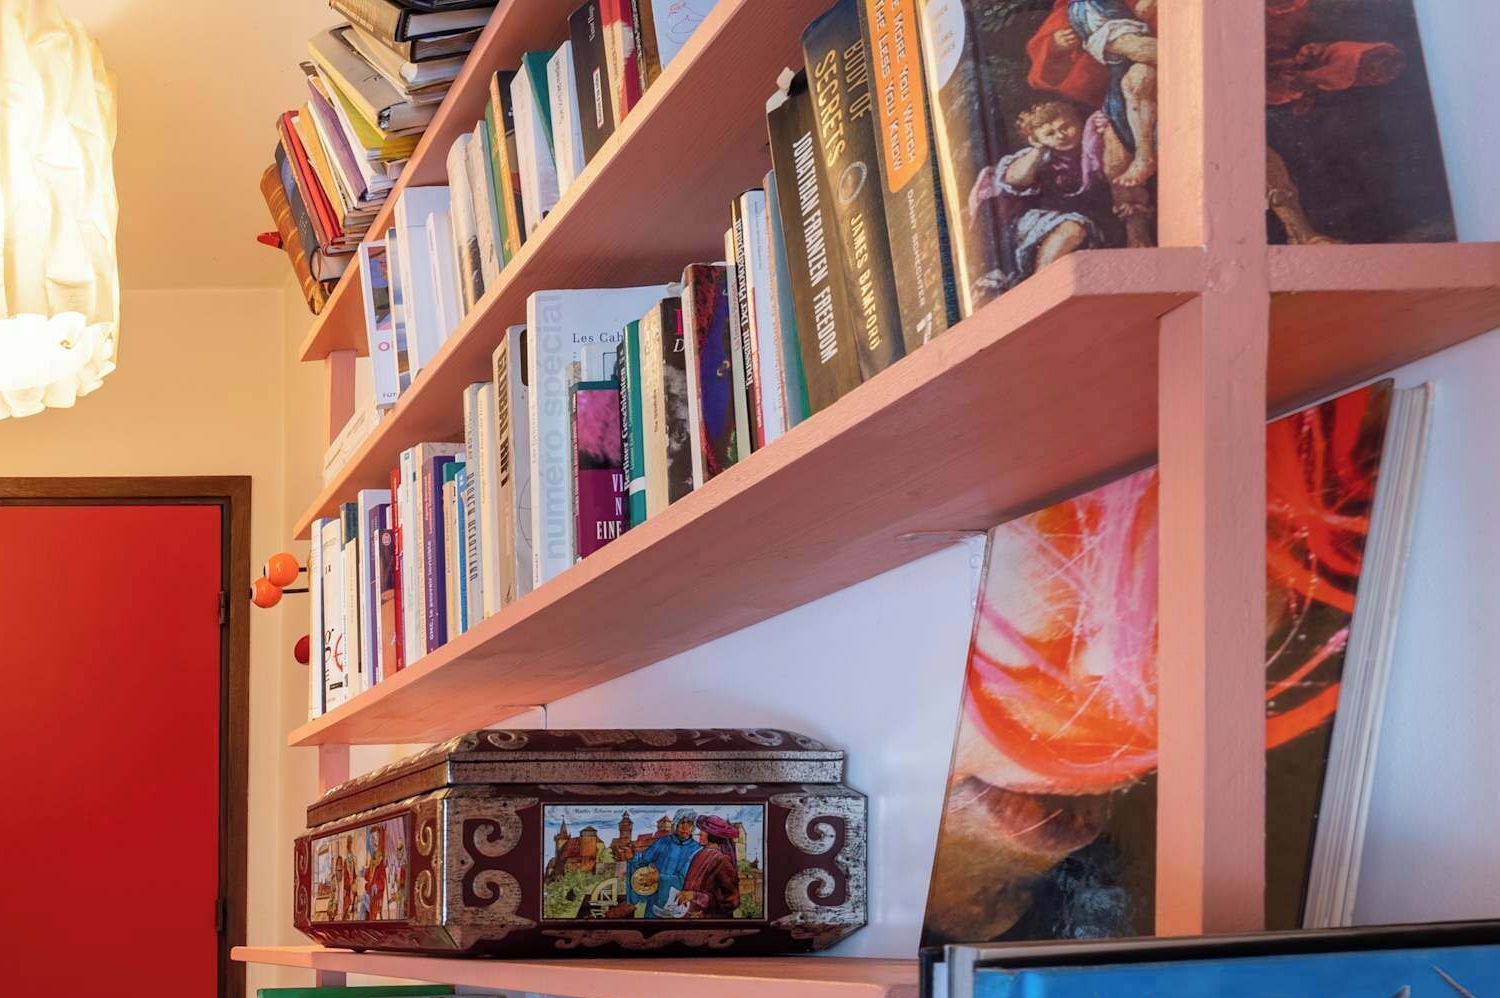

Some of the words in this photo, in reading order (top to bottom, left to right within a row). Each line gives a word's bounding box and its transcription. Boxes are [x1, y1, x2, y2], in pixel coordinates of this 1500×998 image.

[844, 39, 868, 92] BODY
[879, 33, 891, 79] LESS
[894, 12, 905, 64] MORE
[815, 50, 846, 167] SECRETS
[849, 93, 872, 121] OF
[885, 79, 894, 117] YOU
[899, 65, 910, 102] YOU
[889, 120, 903, 171] KNOW
[903, 106, 916, 162] WATCH
[793, 131, 820, 216] JONATHAN
[735, 218, 748, 300] Photoapparat
[803, 209, 828, 287] FRANZEN
[851, 213, 869, 269] JAMES
[740, 302, 750, 326] Der
[813, 286, 838, 364] FREEDOM
[858, 269, 882, 350] BAMFORD
[572, 333, 594, 343] Les
[742, 330, 754, 386] Toussaint
[497, 349, 510, 437] GLOBAL
[619, 367, 629, 438] Geschichten
[540, 422, 567, 559] numéro
[622, 441, 630, 490] Berliner
